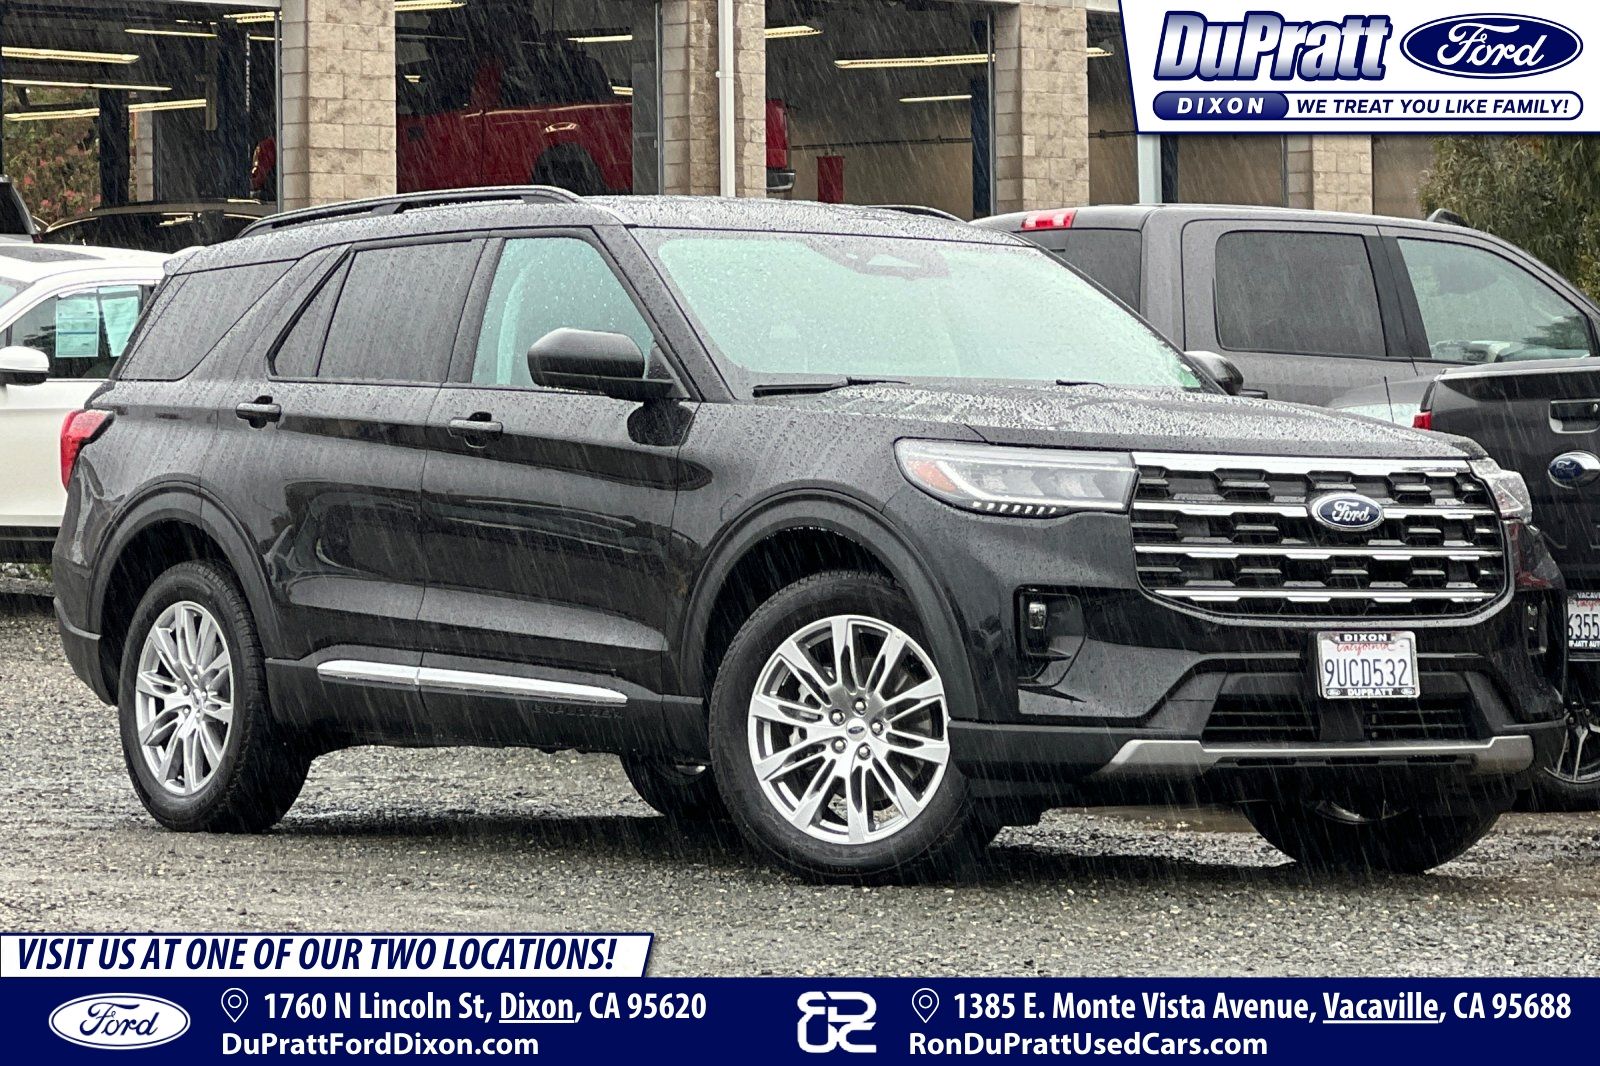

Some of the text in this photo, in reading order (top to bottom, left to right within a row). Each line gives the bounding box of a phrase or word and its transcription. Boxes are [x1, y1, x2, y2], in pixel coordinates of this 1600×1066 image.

[1331, 500, 1370, 522] Ford
[1343, 634, 1388, 642] DIXON
[1324, 658, 1410, 687] 9UCD532
[1347, 688, 1394, 696] DUPRATT
